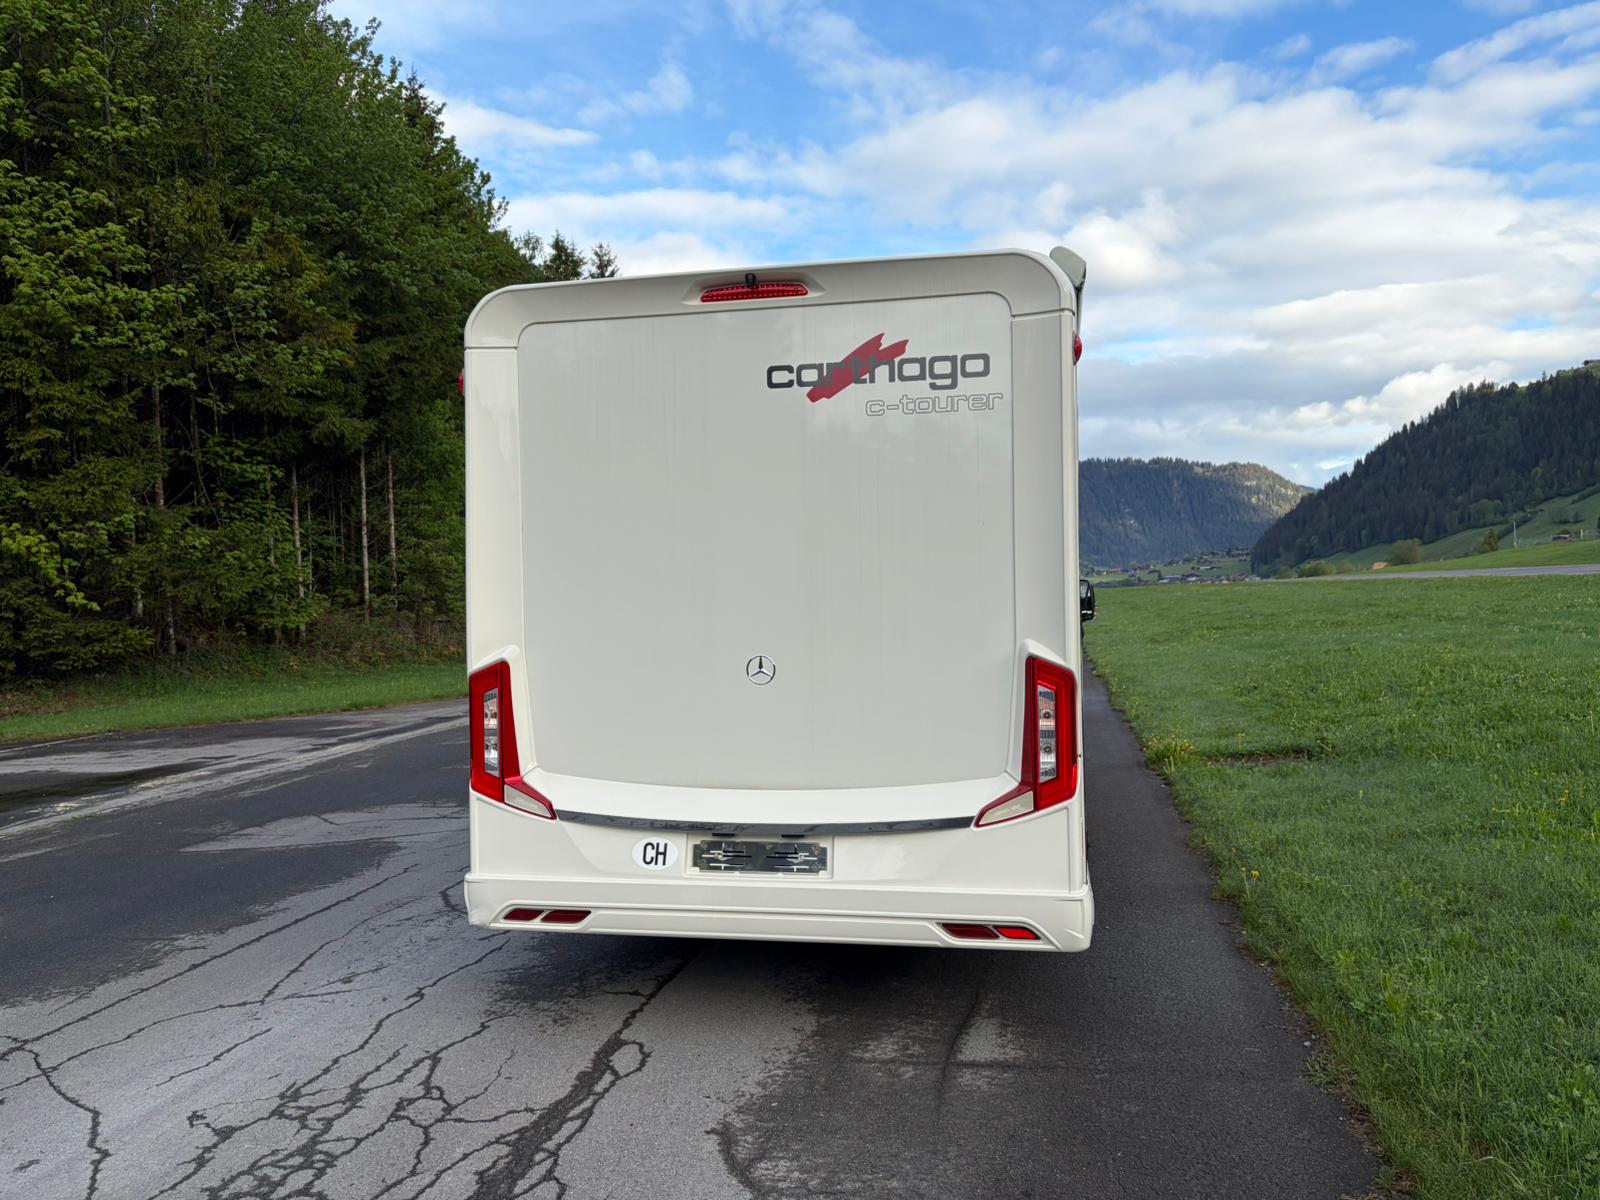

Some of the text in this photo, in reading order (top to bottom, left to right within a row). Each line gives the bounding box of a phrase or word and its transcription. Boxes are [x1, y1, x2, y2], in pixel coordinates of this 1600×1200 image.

[766, 353, 990, 390] carthago
[865, 392, 1003, 416] c-tourer
[642, 842, 668, 866] CH
